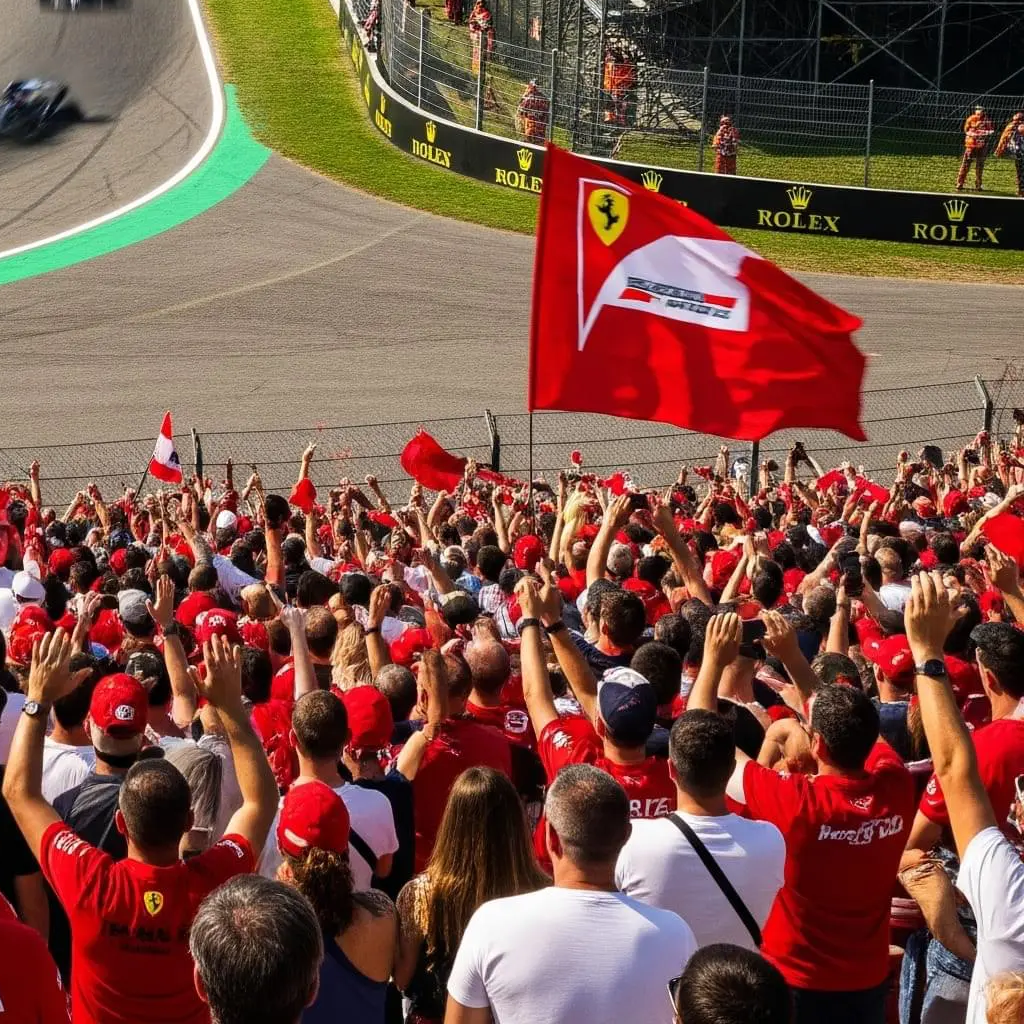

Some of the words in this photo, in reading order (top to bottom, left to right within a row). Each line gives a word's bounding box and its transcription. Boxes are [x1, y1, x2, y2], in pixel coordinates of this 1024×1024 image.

[494, 167, 543, 194] ROLE
[757, 209, 841, 233] ROLEX
[912, 222, 1002, 244] ROLEX
